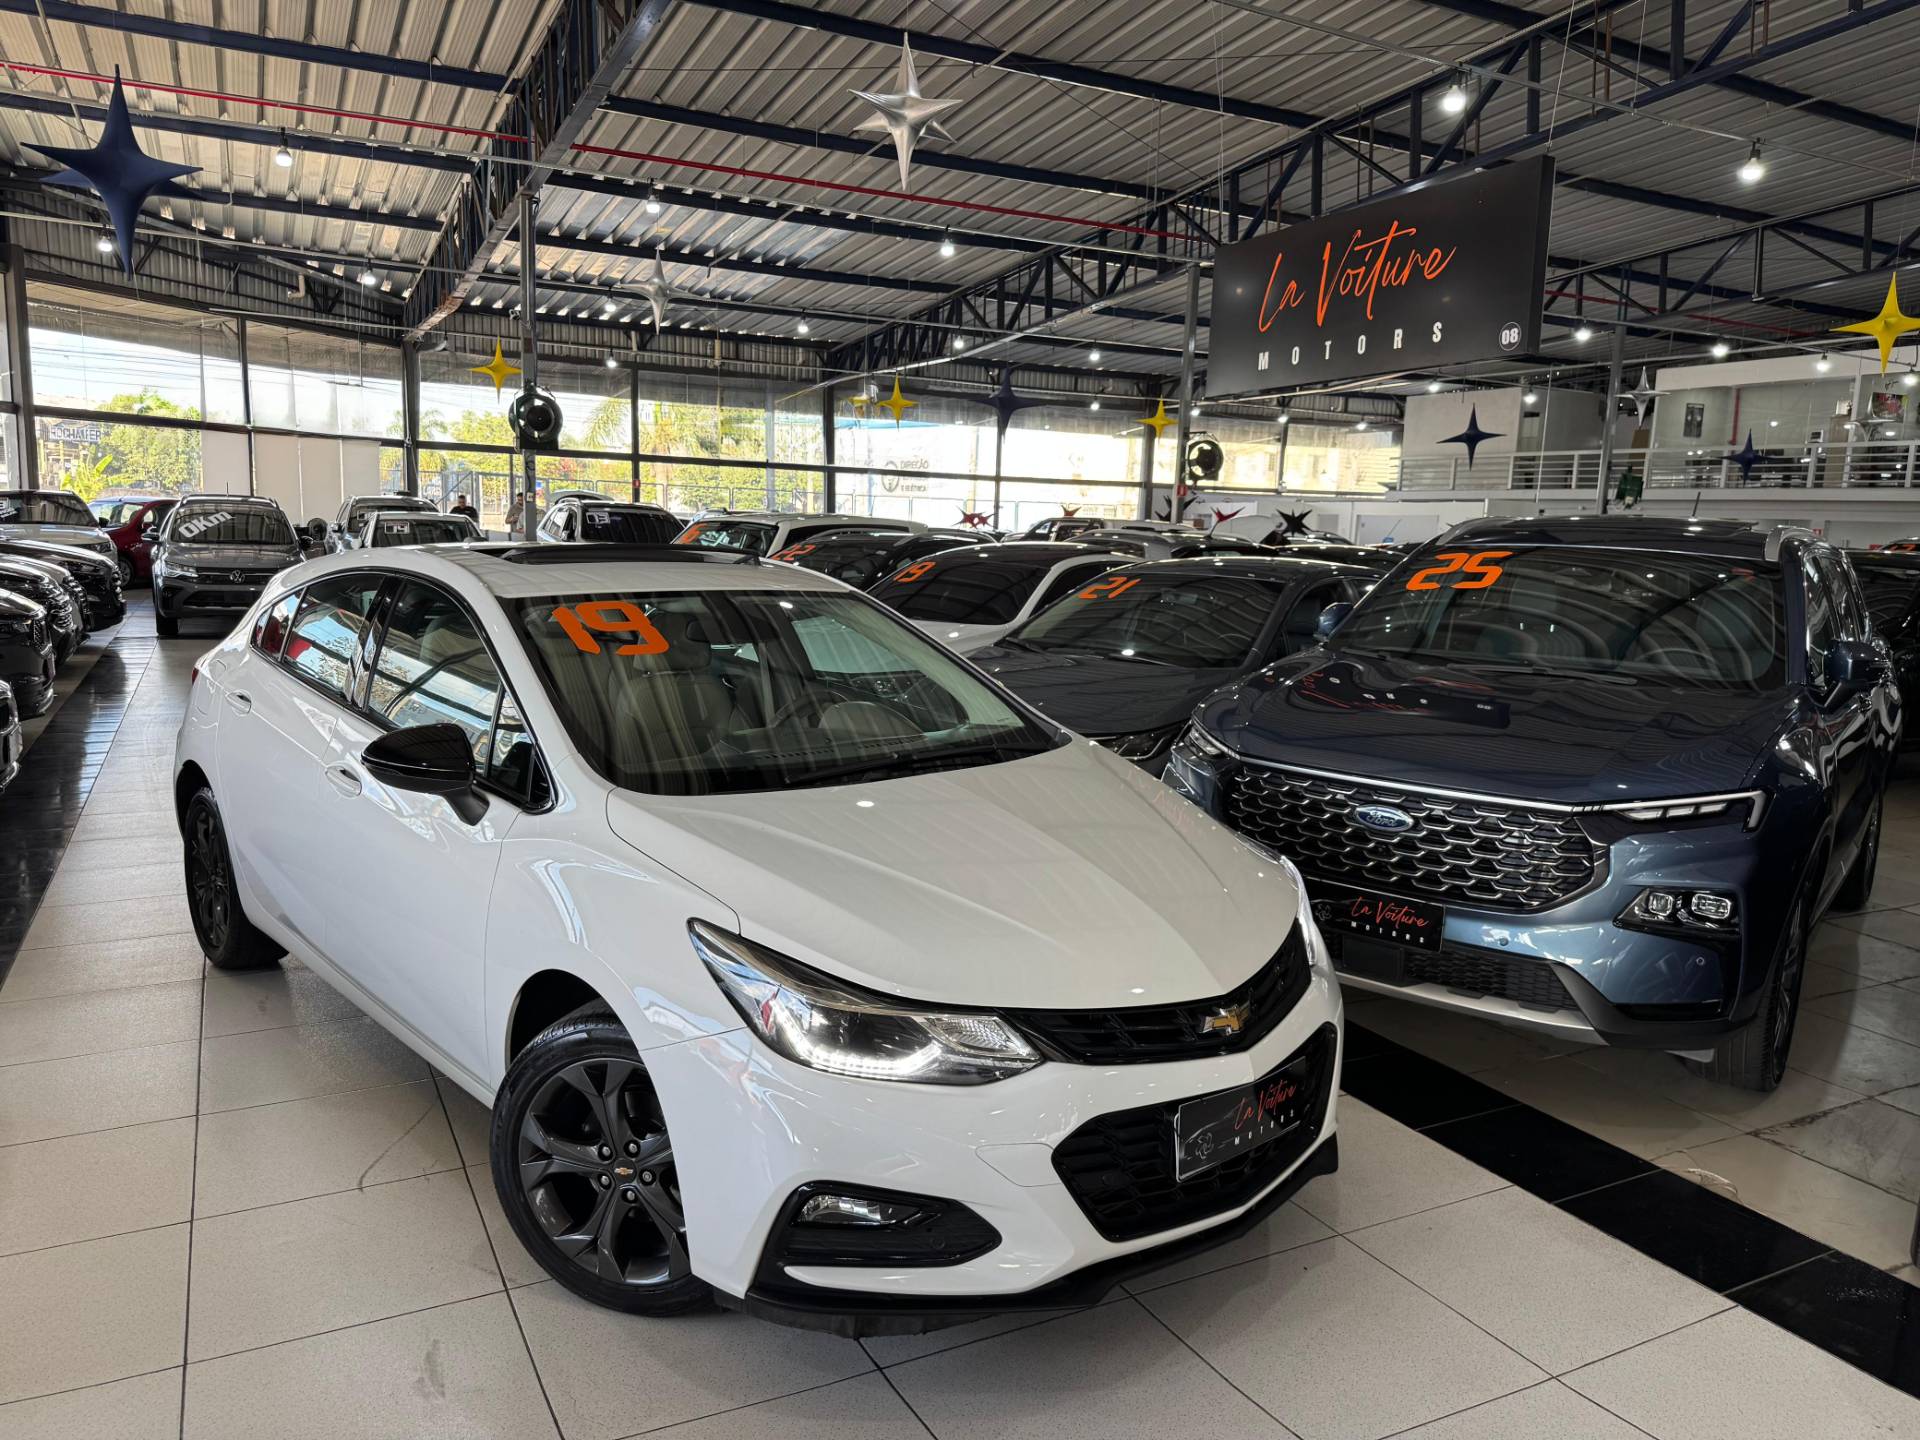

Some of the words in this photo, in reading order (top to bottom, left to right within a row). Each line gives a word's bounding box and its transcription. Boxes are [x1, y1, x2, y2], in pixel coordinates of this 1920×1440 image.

[1258, 252, 1305, 333] La
[1316, 220, 1457, 328] Voiture
[1258, 321, 1443, 371] MOTORS
[1501, 328, 1520, 345] 08
[1078, 576, 1141, 599] 21
[1406, 551, 1514, 591] 25
[552, 600, 670, 656] 19
[1366, 811, 1398, 827] Ford
[1351, 896, 1372, 917] La
[1376, 901, 1429, 929] Voiture
[1351, 921, 1425, 943] MOTORS
[1234, 1097, 1254, 1130] La
[1257, 1079, 1297, 1122] Voiture
[1234, 1109, 1294, 1145] MOTORS
